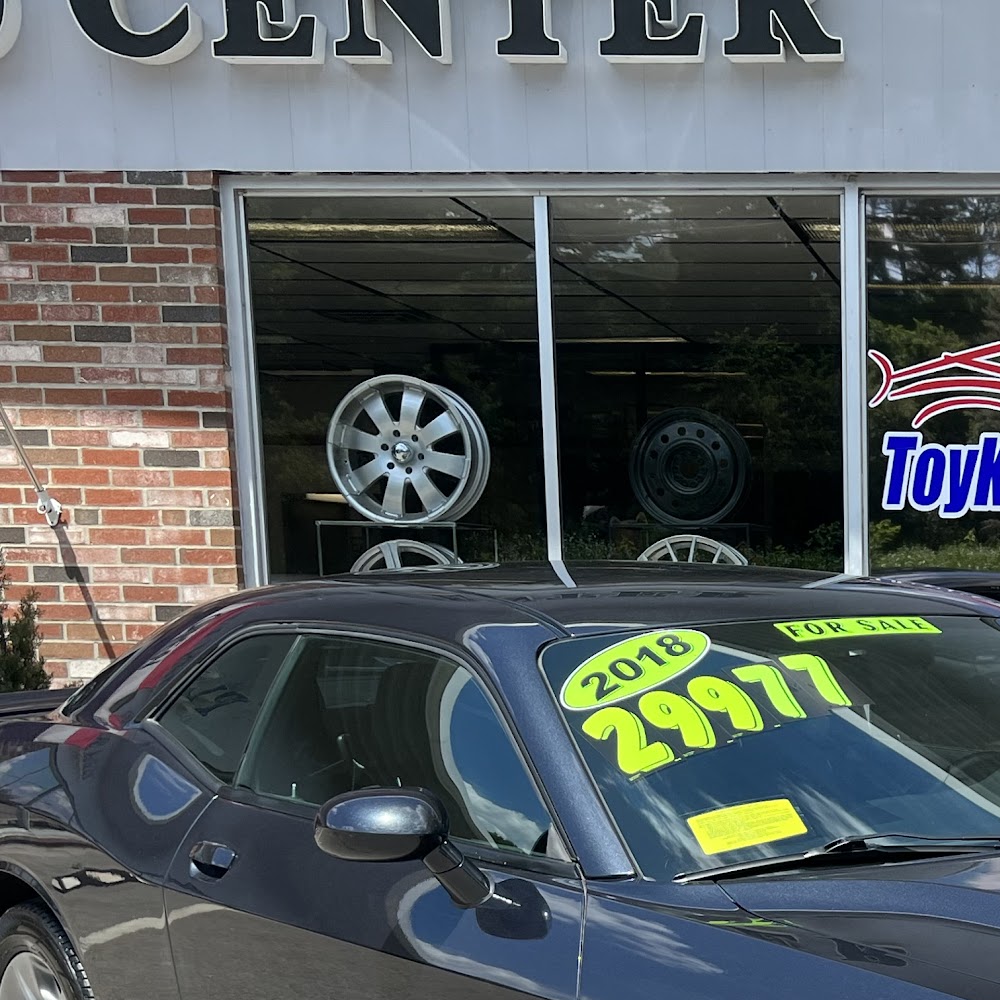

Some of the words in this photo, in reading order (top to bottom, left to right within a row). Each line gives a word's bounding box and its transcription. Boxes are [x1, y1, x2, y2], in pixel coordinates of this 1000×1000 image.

[784, 621, 846, 638] FOR
[857, 619, 929, 631] SALE
[581, 634, 694, 701] 2018
[582, 653, 852, 774] 29977
